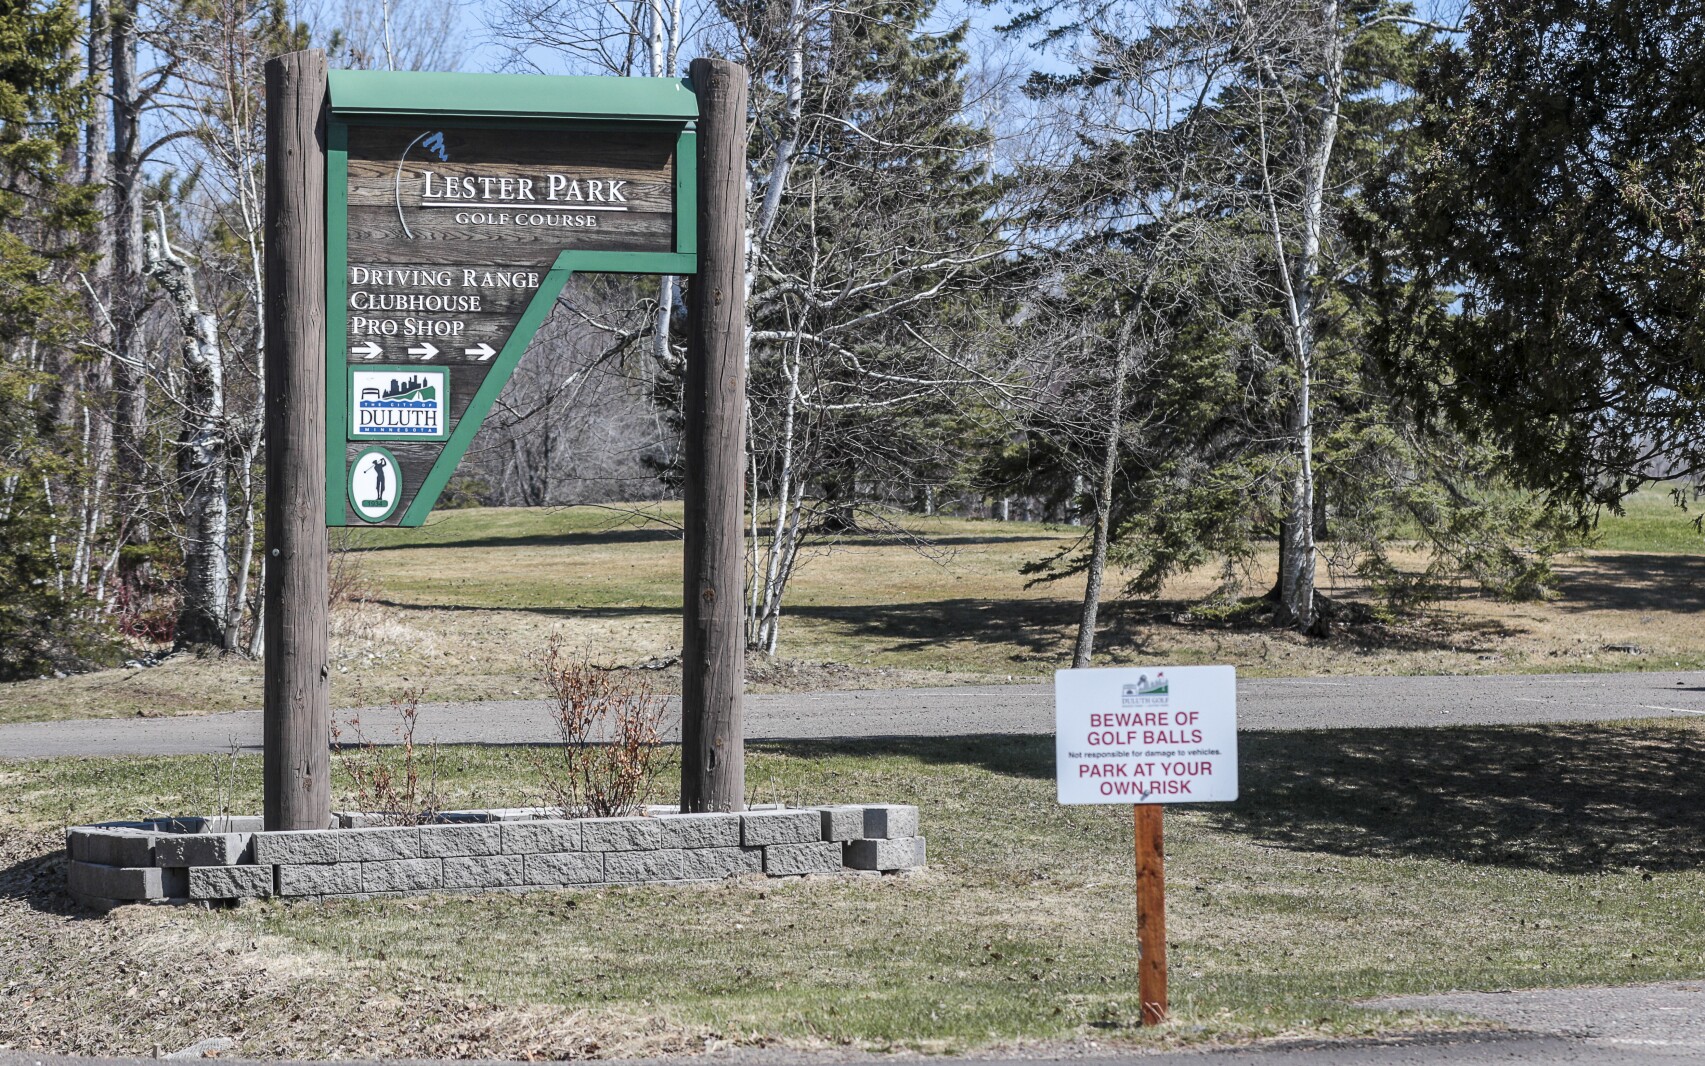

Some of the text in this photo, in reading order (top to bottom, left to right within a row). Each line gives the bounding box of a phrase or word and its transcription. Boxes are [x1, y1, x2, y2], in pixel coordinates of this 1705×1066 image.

[421, 170, 628, 202] LESTER PARK
[455, 212, 597, 227] GOLF COURSE
[351, 266, 540, 288] DRIVING RANGE
[350, 291, 482, 312] CLUBHOUSE
[351, 316, 465, 336] PRO SHOP
[360, 409, 437, 426] DULUTH
[1090, 711, 1200, 727] BEWARE OF
[1087, 729, 1203, 746] GOLF BALLS
[1068, 748, 1222, 760] Not responsible for damage to vehicles.
[1079, 761, 1212, 778] PARK AT YOUR
[1100, 780, 1193, 796] OWN RISK
